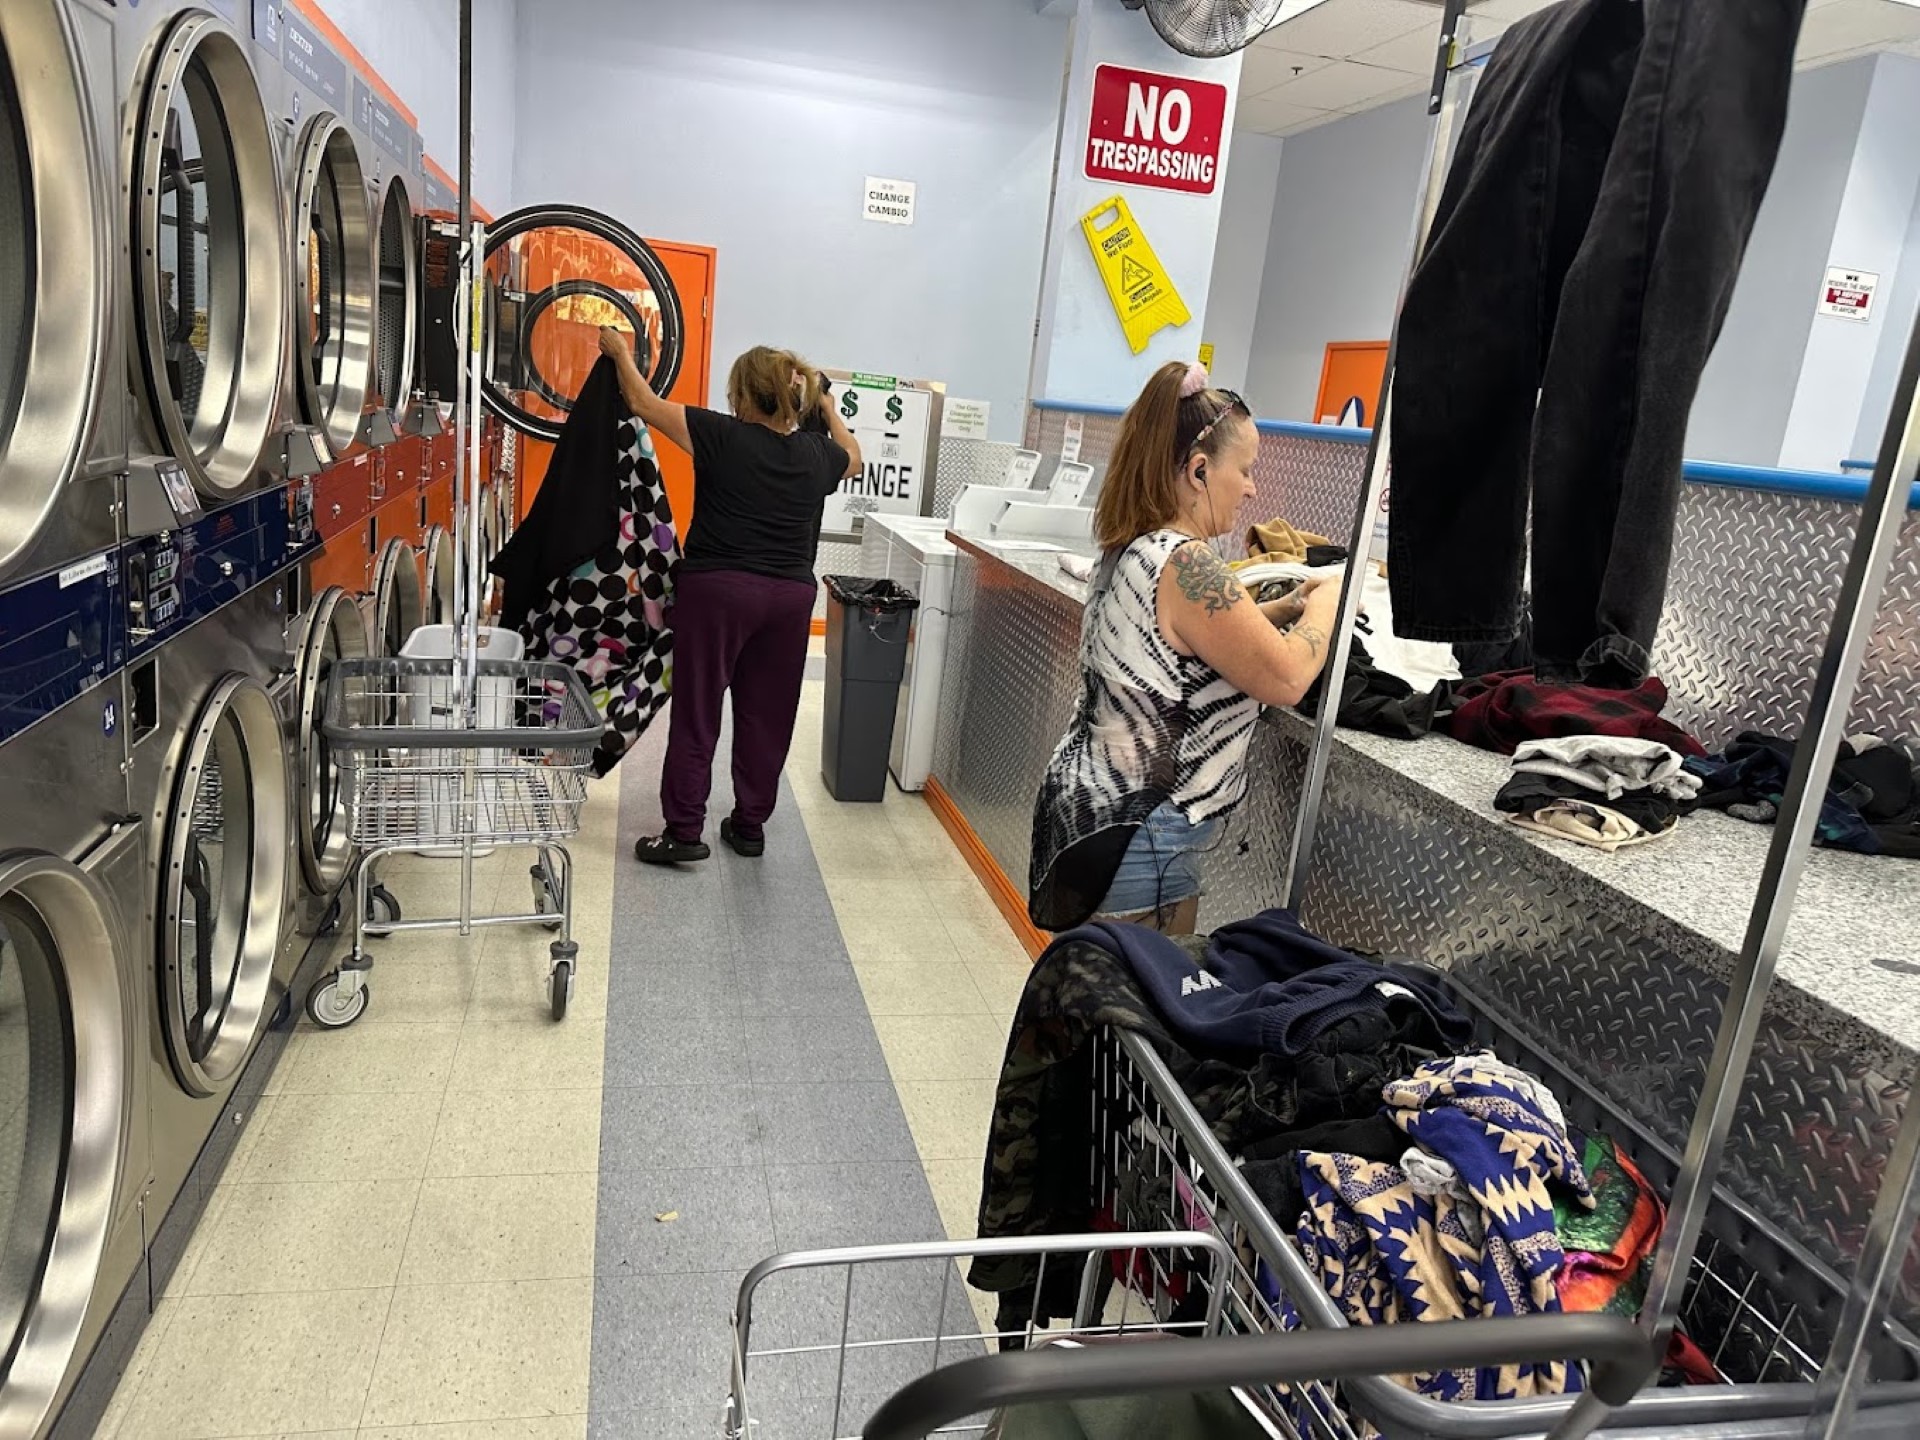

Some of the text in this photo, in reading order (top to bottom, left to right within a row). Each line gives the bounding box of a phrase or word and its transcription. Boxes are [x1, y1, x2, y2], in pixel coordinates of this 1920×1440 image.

[1123, 82, 1192, 145] NO
[1091, 137, 1215, 184] TRESPASSING
[868, 204, 908, 218] CAMBIO
[869, 191, 910, 203] CHANGE
[844, 462, 912, 499] ANGE
